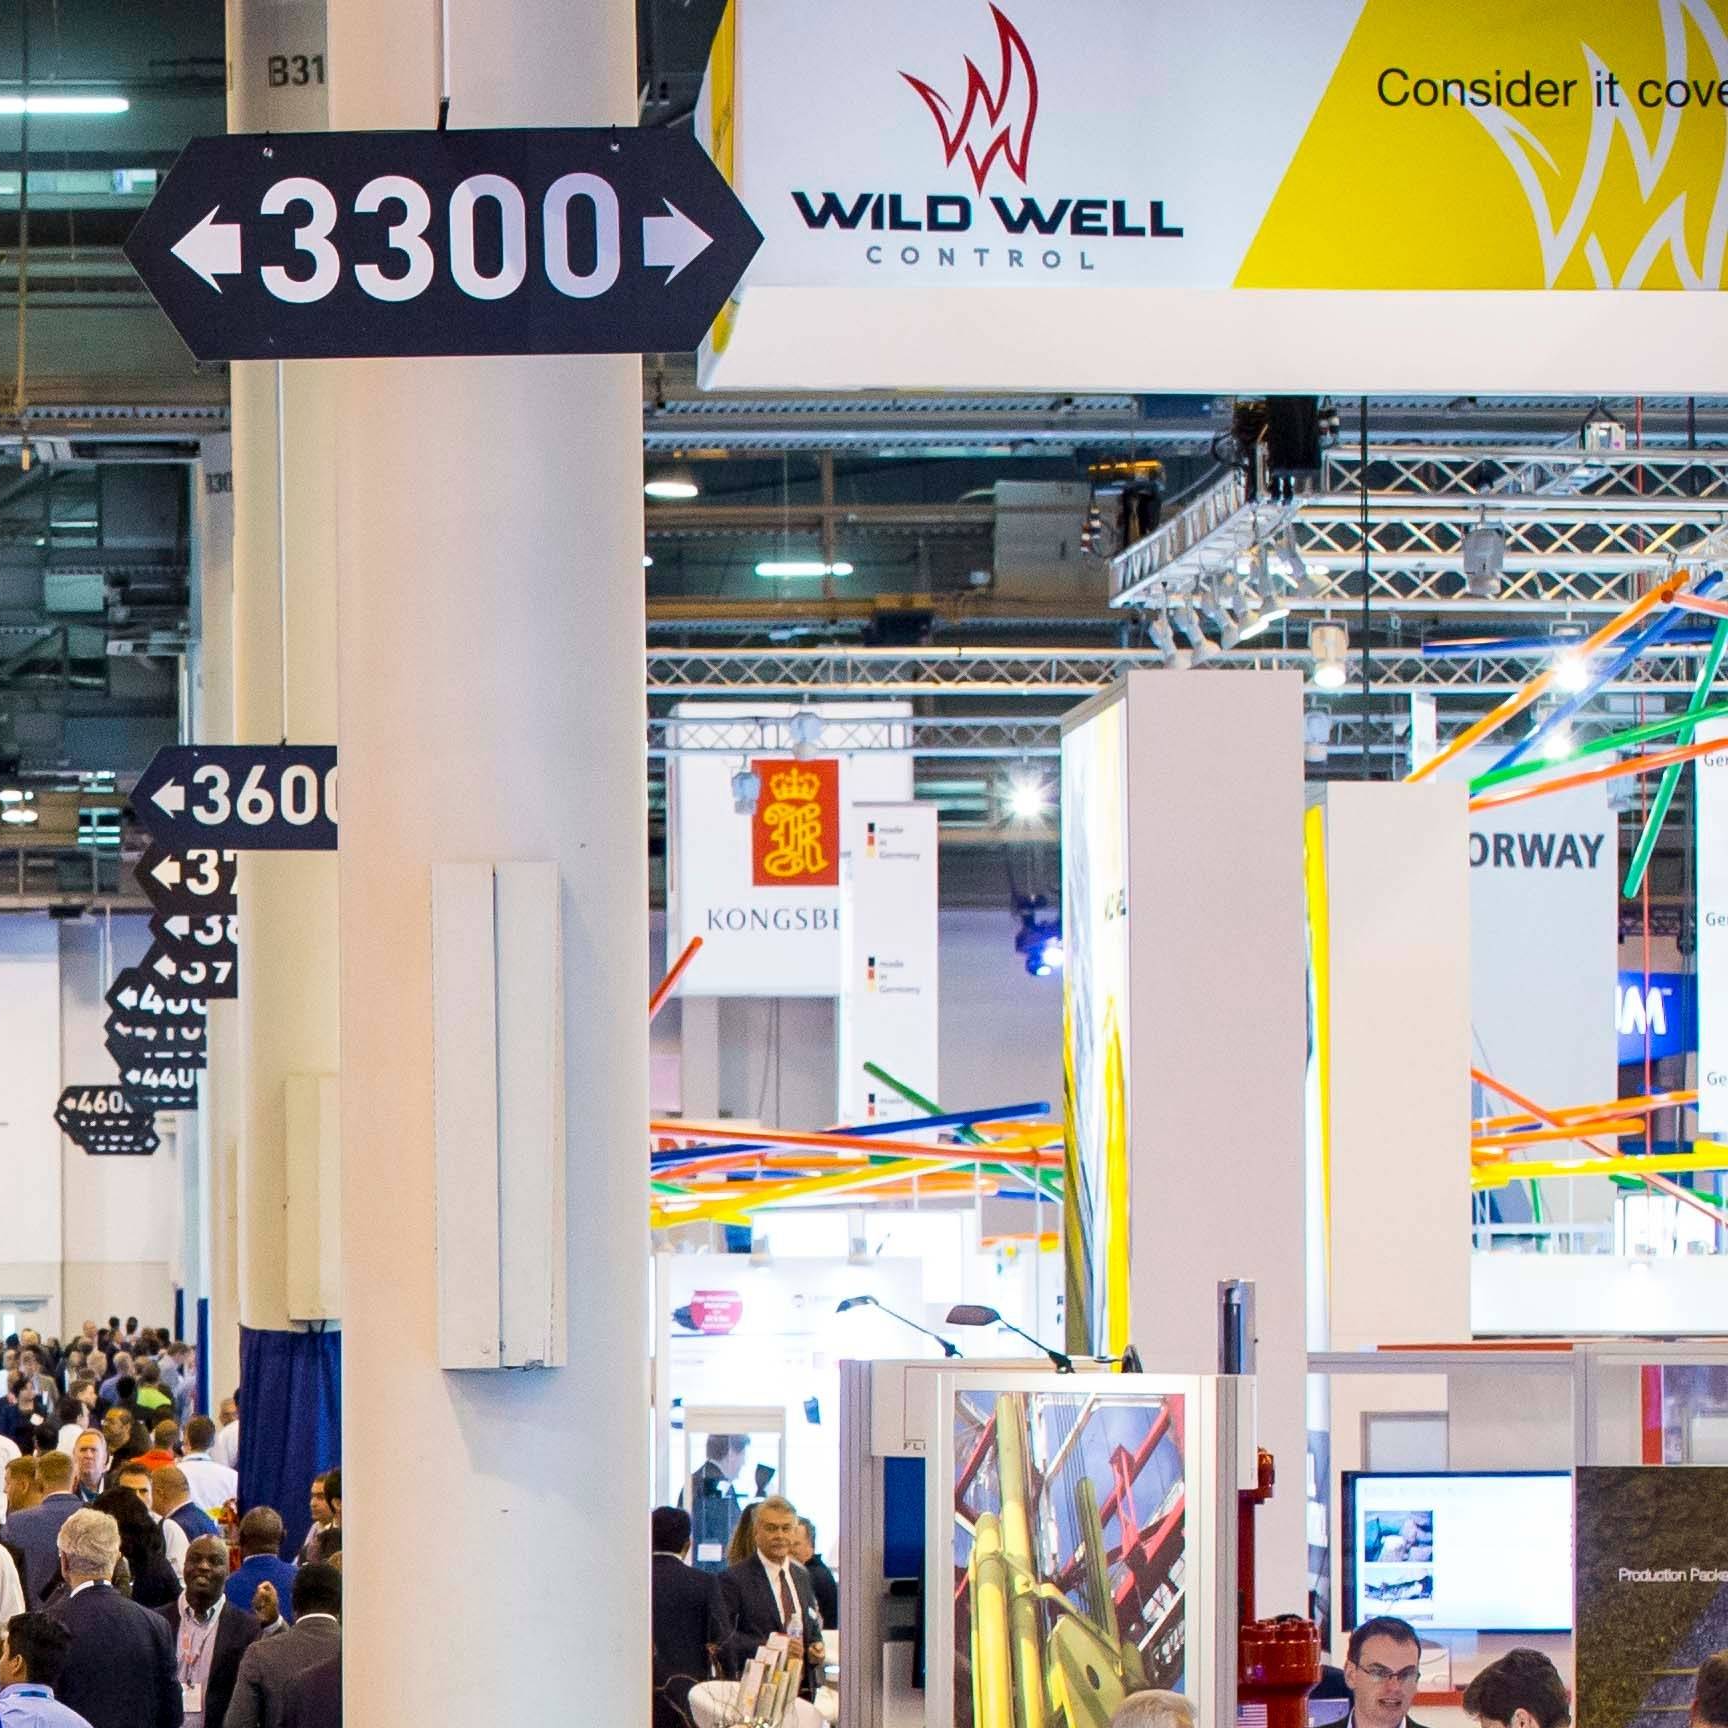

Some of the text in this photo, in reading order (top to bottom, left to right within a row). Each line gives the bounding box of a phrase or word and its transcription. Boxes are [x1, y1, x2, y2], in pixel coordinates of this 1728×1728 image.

[1376, 67, 1578, 109] Consider
[1594, 68, 1621, 108] it
[790, 191, 1185, 237] WILD WELL
[260, 172, 621, 304] 3300
[865, 244, 1096, 271] CONTROL
[1618, 1567, 1688, 1582] Production
